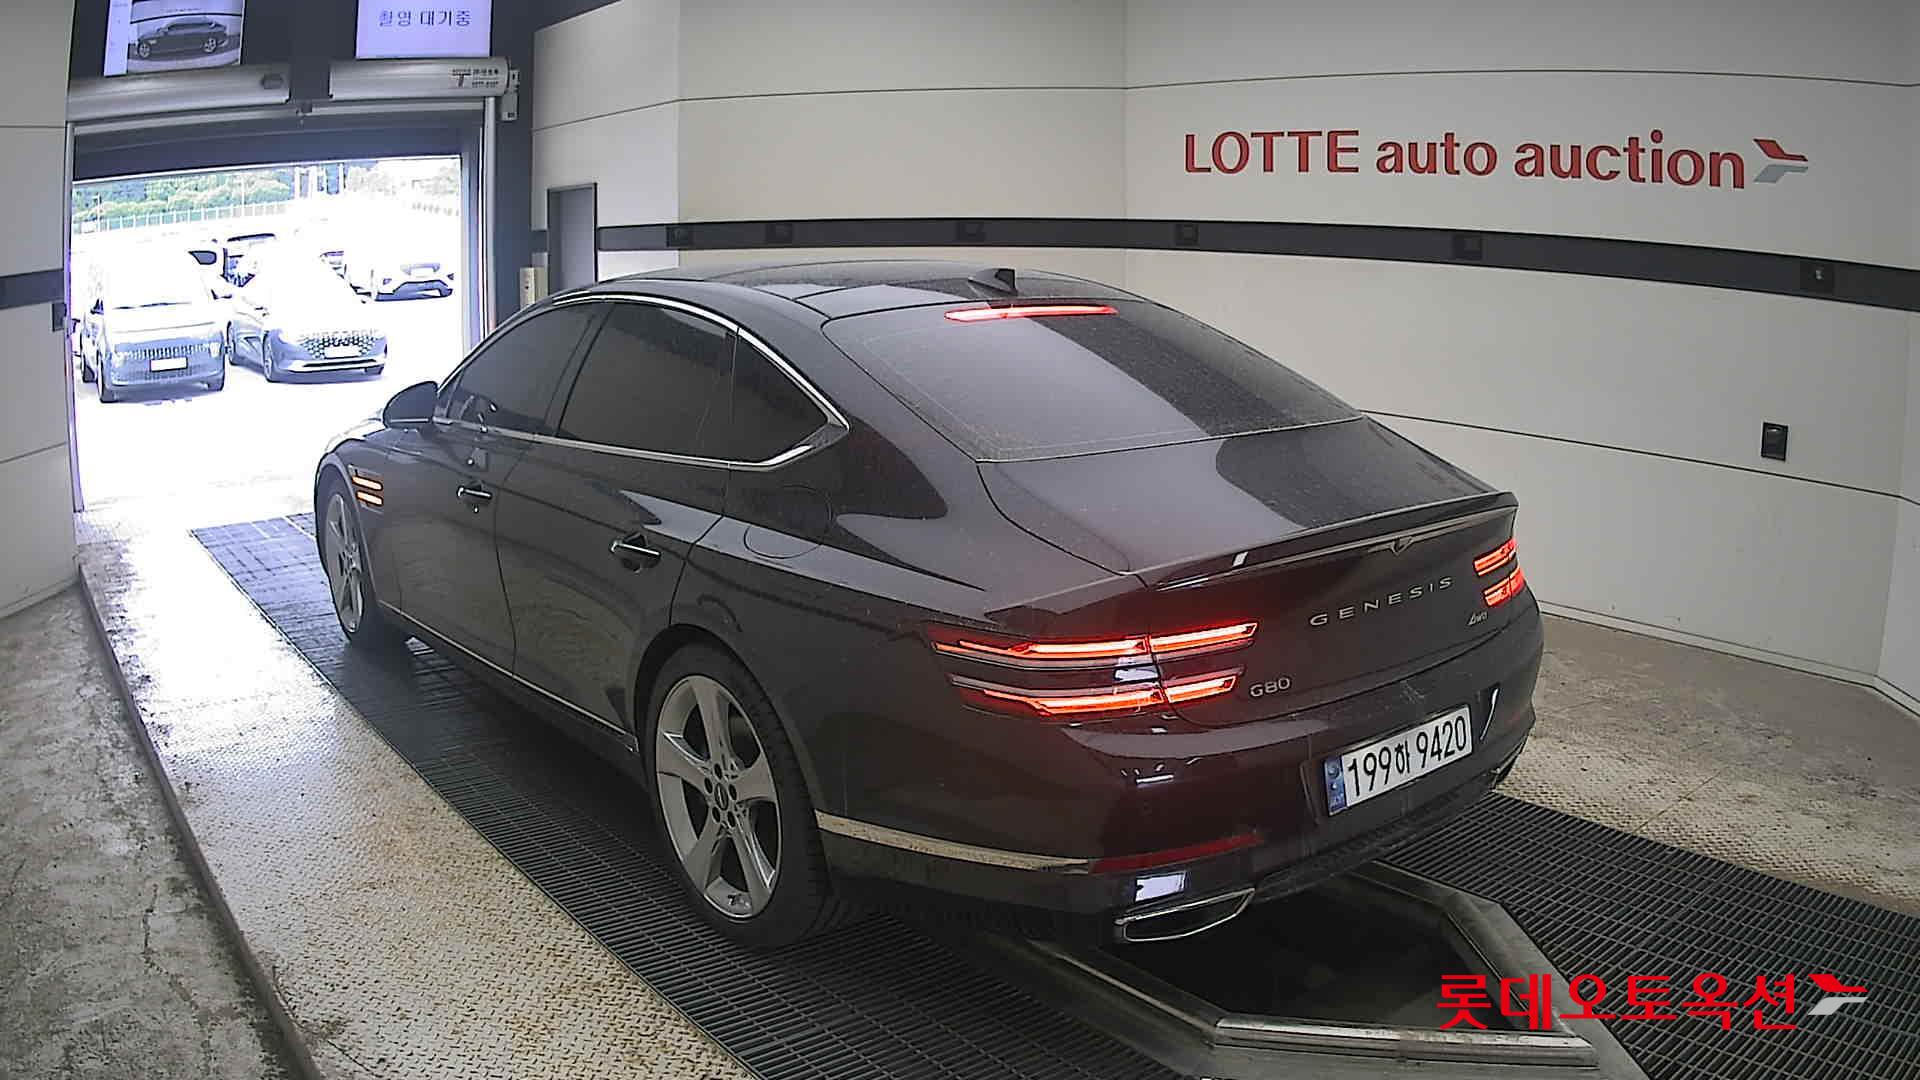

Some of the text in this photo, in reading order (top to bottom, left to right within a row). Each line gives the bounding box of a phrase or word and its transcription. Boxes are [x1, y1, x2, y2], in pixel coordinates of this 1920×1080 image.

[420, 10, 471, 27] 대기중
[1185, 130, 1745, 189] LOTTE auto auction
[1309, 576, 1453, 627] GENESIS
[1250, 676, 1291, 698] G80
[1348, 716, 1466, 796] 199하 9420
